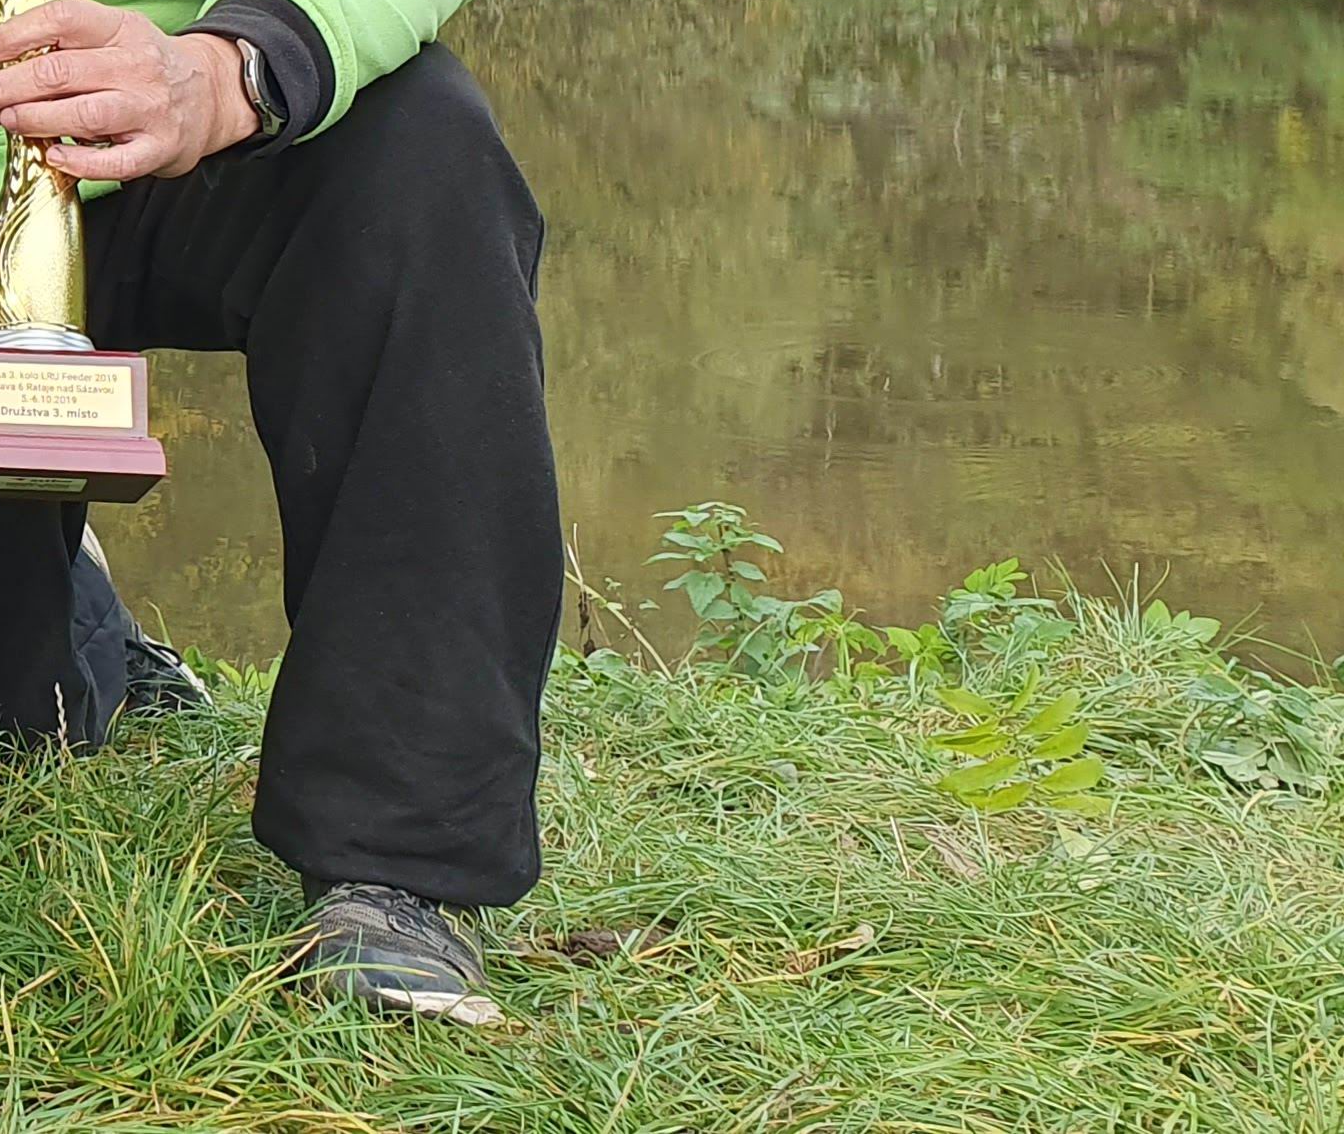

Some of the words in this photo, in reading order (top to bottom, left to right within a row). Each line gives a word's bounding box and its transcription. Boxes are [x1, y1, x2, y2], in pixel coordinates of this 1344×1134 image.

[20, 370, 39, 380] kolo
[62, 372, 92, 382] Feeder
[95, 373, 118, 383] 2019
[26, 383, 55, 394] Rataje
[57, 384, 74, 393] nad
[1, 406, 50, 418] Družstva
[53, 408, 63, 418] 3.
[67, 409, 99, 419] místo
